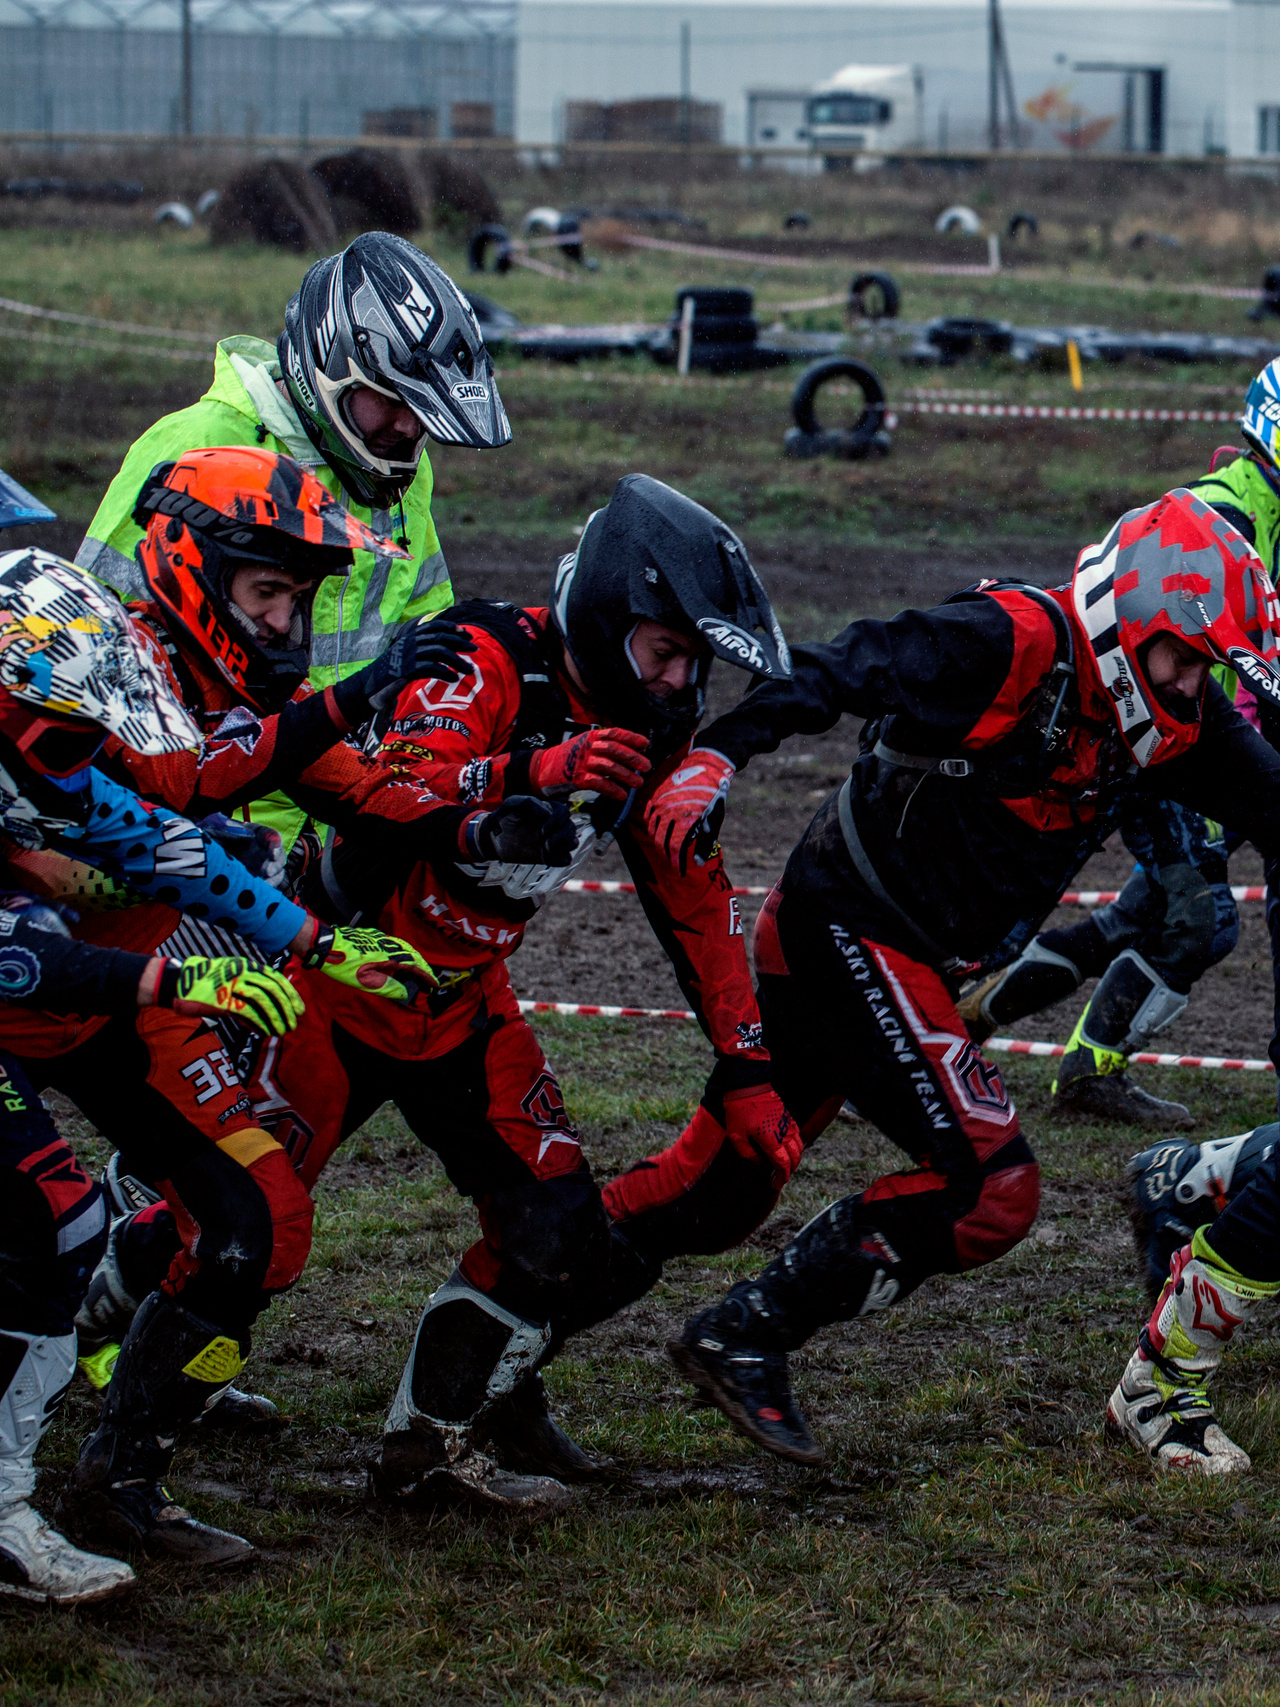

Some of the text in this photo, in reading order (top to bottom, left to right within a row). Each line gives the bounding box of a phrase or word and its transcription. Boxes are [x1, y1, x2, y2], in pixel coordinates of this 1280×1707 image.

[294, 367, 315, 408] SHOEI
[456, 385, 486, 398] SHOEI
[143, 486, 254, 545] 100%
[1196, 601, 1213, 628] Airoh
[704, 625, 765, 670] Airoh
[863, 988, 918, 1062] RACING
[909, 1069, 952, 1128] TEAM
